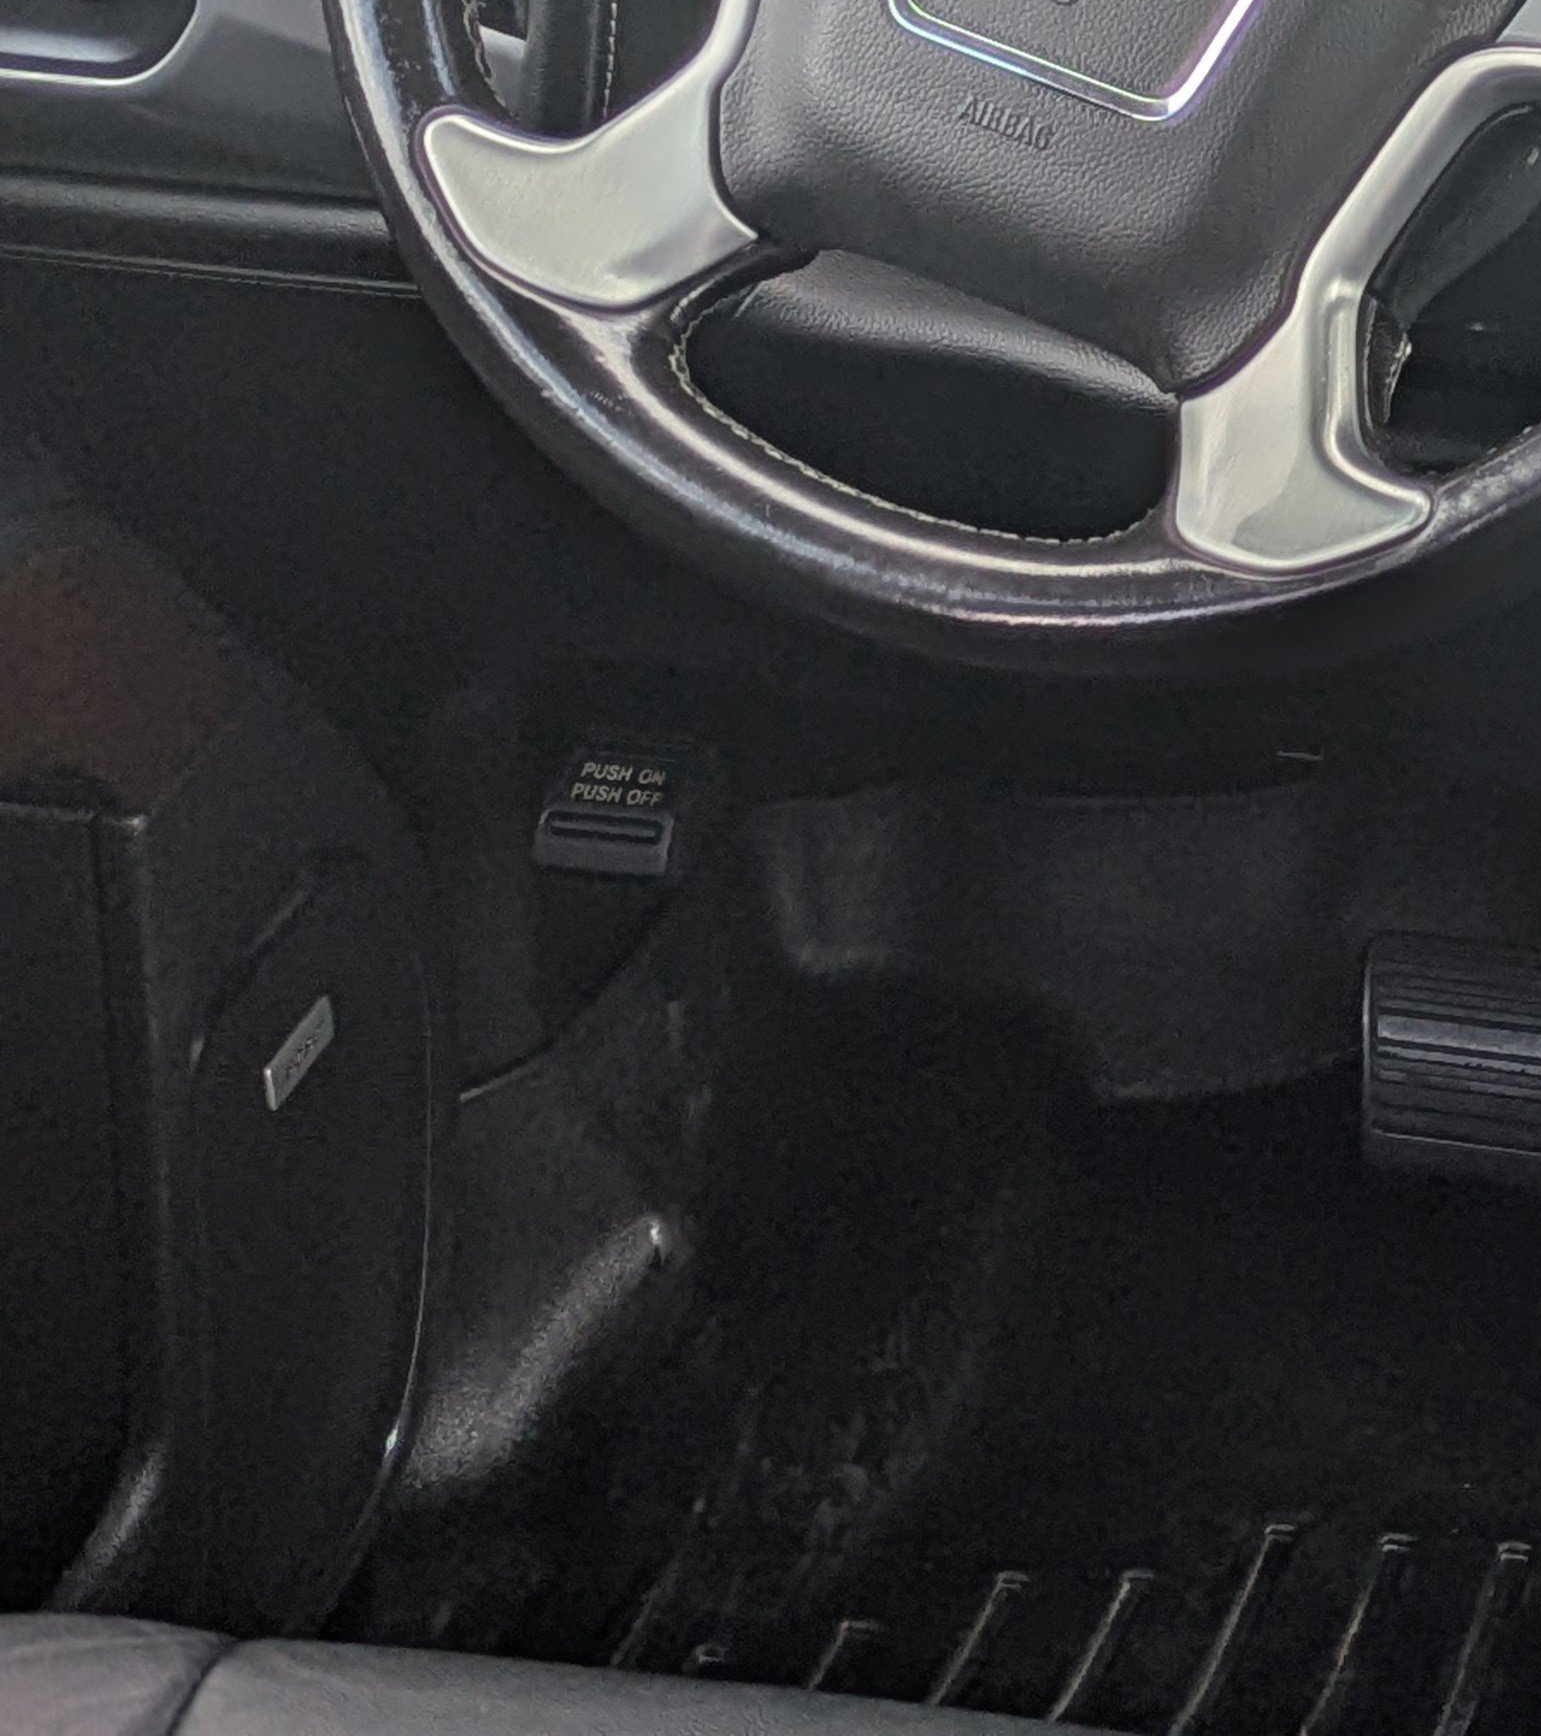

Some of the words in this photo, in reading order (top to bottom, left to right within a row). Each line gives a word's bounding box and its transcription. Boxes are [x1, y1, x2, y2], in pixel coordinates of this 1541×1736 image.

[957, 93, 1053, 152] AIRBAG
[581, 762, 633, 781] PUSH
[639, 769, 666, 785] ON
[571, 783, 623, 803] PUSH
[627, 789, 662, 806] OFF
